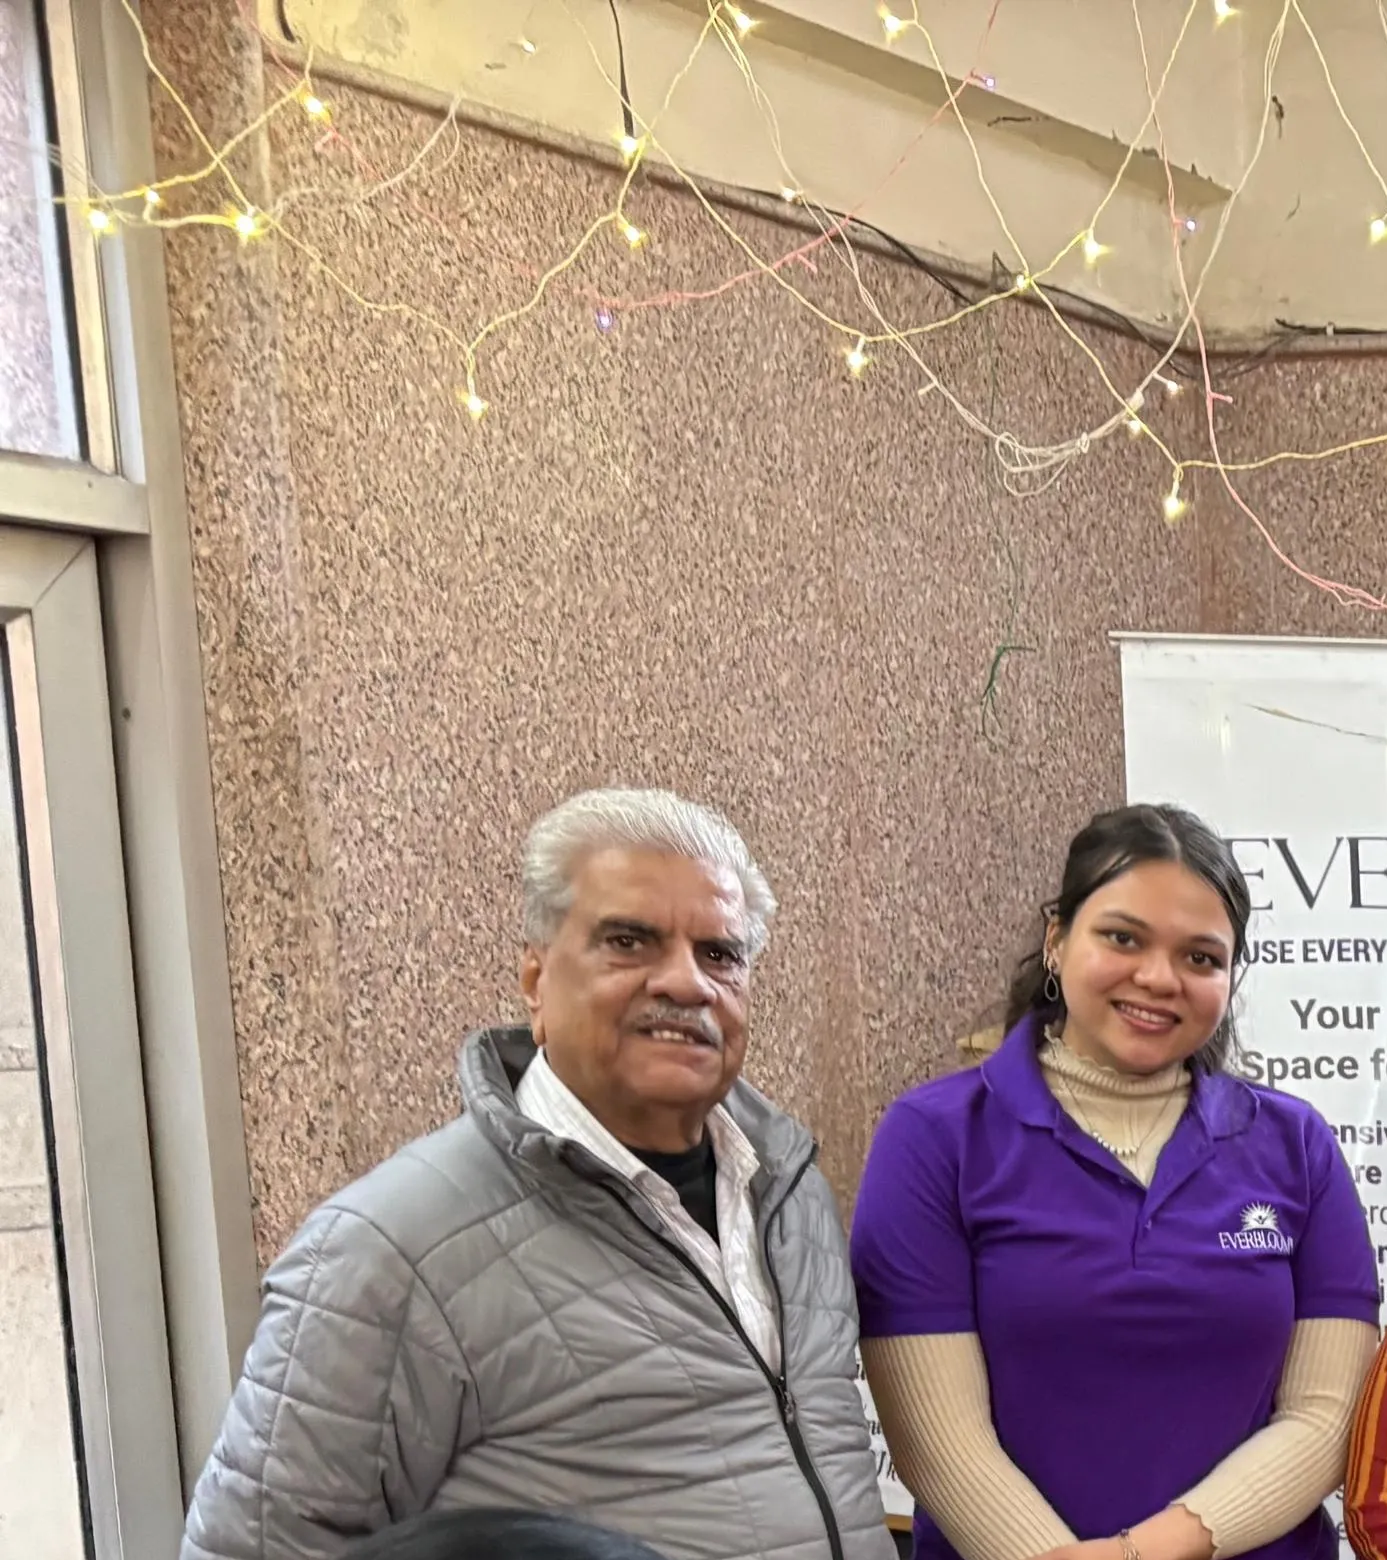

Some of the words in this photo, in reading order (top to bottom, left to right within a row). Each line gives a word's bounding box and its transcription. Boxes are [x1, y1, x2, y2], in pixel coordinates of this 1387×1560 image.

[1243, 938, 1295, 966] USE
[1302, 938, 1387, 964] EVERY
[1290, 998, 1380, 1031] Your
[1242, 1050, 1359, 1088] Space
[1218, 1230, 1294, 1255] EVERBLOOM
